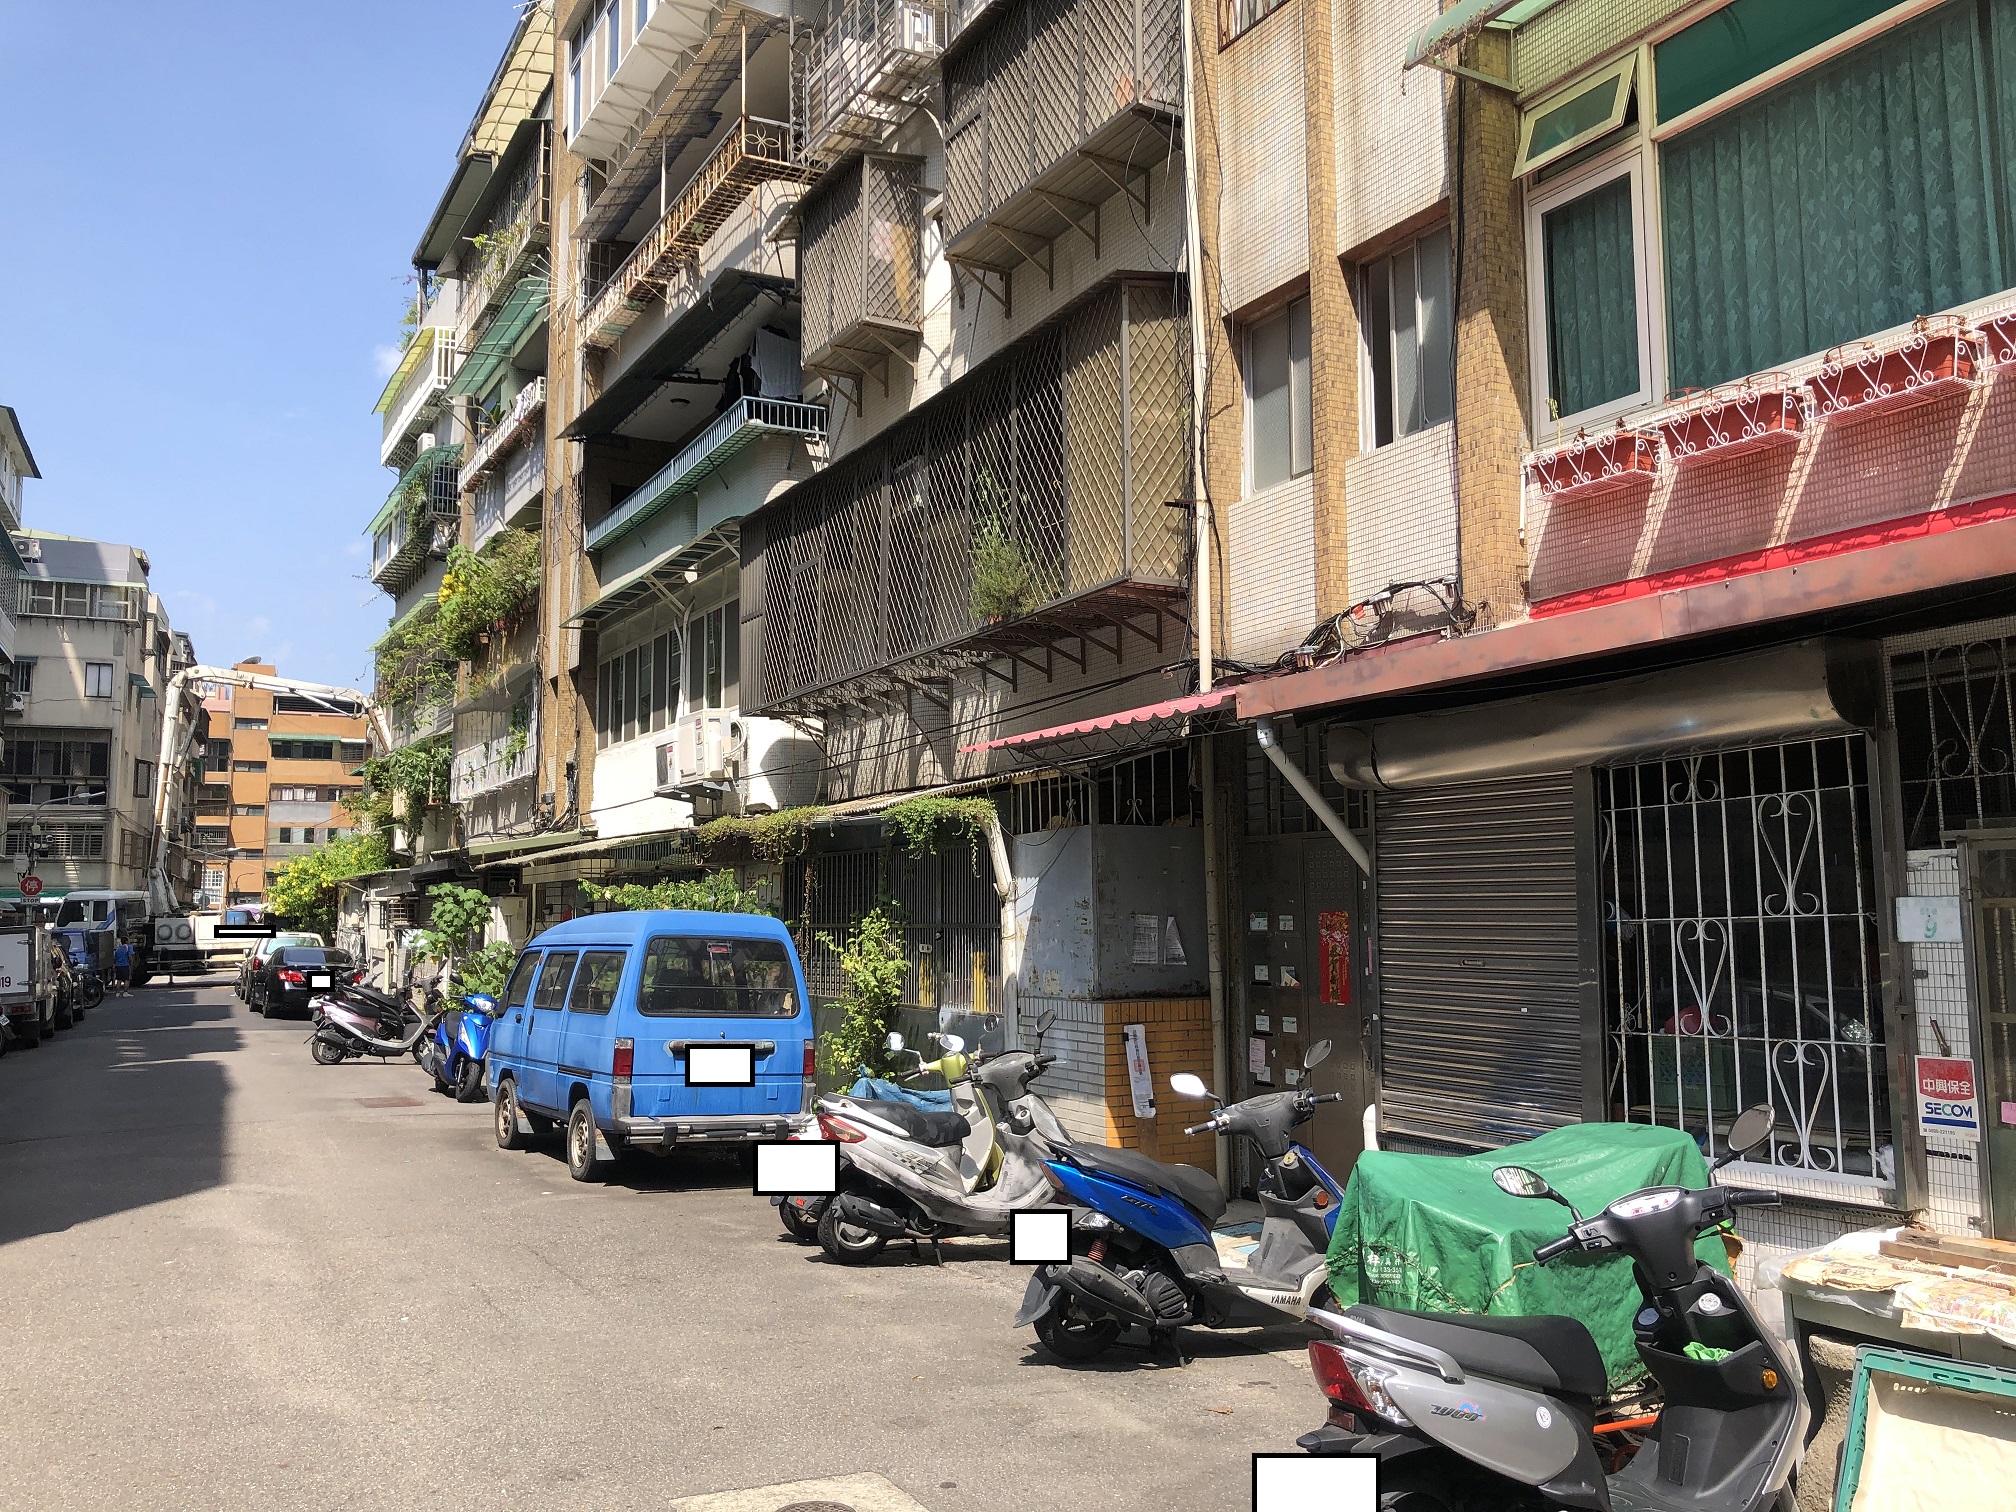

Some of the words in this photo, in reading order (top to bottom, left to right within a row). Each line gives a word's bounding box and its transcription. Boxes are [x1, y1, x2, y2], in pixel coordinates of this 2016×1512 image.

[25, 880, 38, 892] 停
[1922, 1078, 1971, 1096] 中興保全
[1924, 1101, 1973, 1118] SECOM
[1270, 1294, 1302, 1306] YAMAHA
